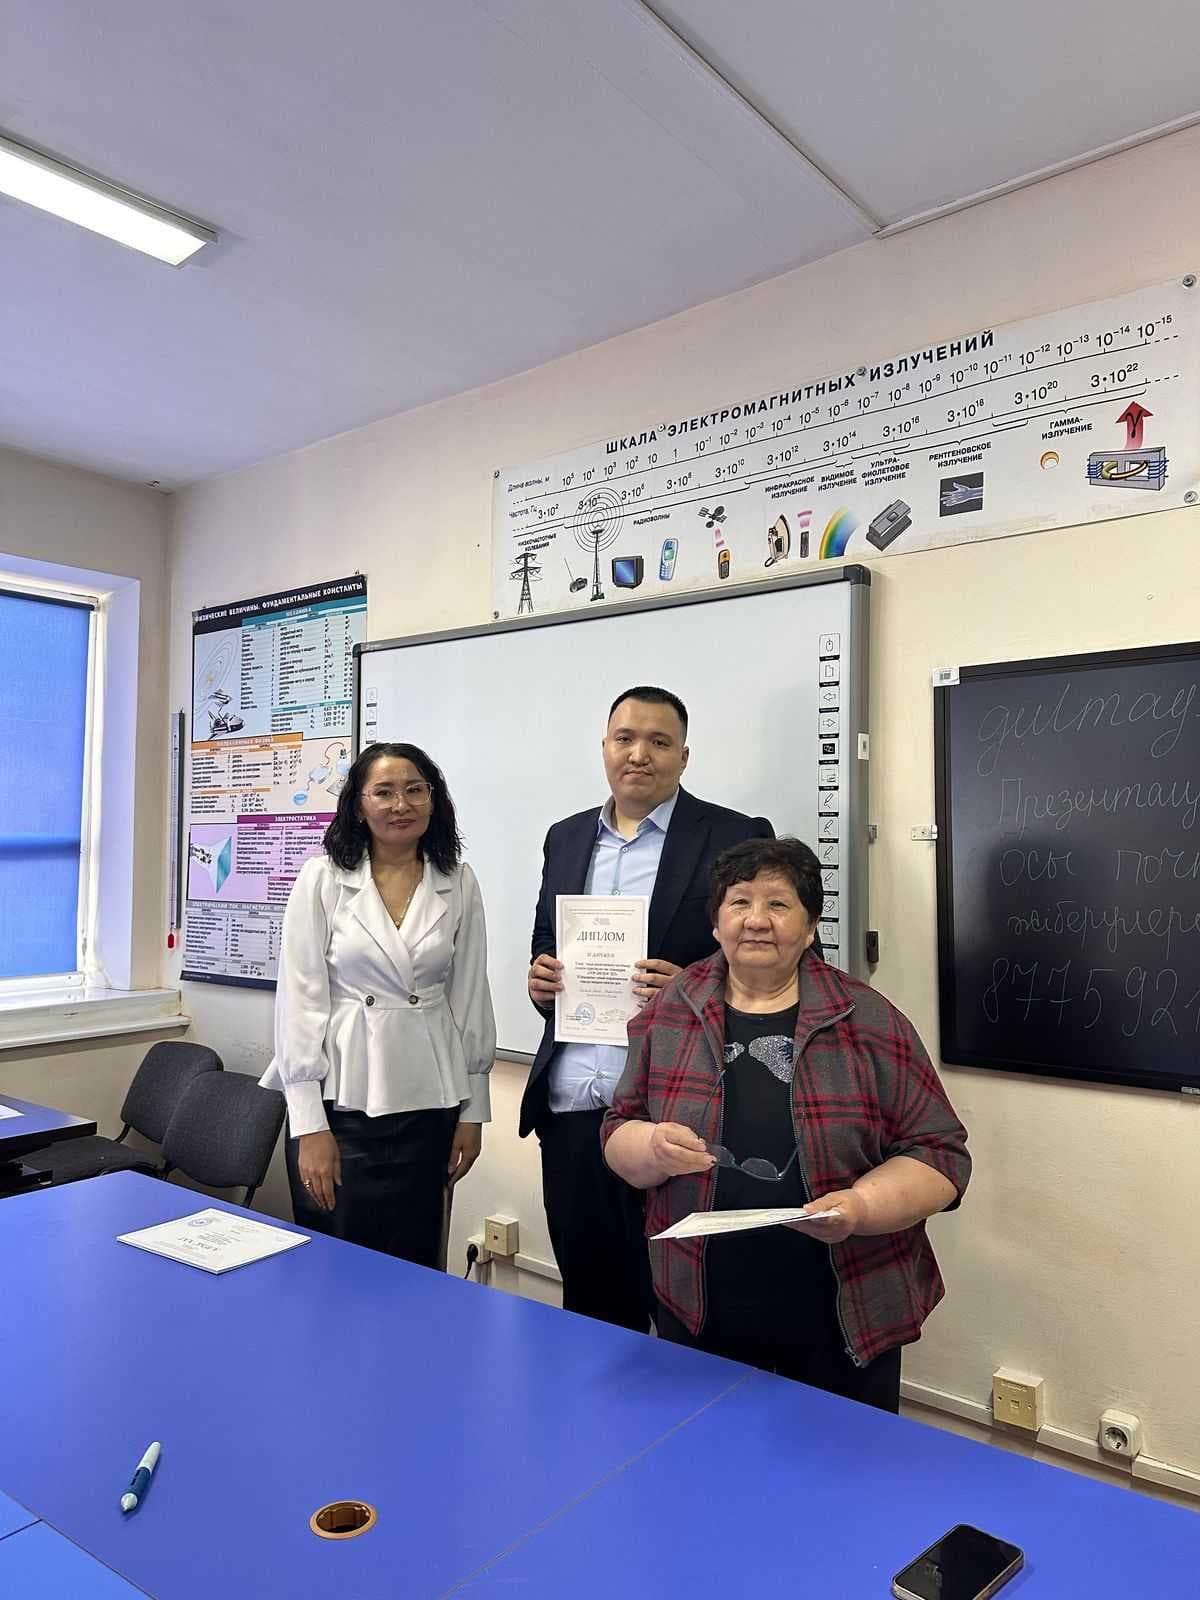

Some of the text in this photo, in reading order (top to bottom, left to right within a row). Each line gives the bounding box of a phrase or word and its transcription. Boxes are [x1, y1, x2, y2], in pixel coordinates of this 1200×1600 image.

[606, 329, 994, 454] ШКАЛА ЭЛЕКТРОМАГНИТНЫХ ИЗЛУЧЕНИЙ
[1050, 416, 1083, 429] ГАММА-
[1041, 423, 1093, 440] ИЗЛУЧЕНИЕ
[929, 441, 992, 461] РЕНТГЕНОВСКОЕ
[648, 453, 657, 465] 10
[870, 457, 900, 469] УЛЬТРА-
[937, 453, 983, 468] ИЗЛУЧЕНИЕ
[821, 470, 854, 482] ВИДИМОЕ
[861, 463, 910, 479] ФИОЛЕТОВОЕ
[765, 476, 815, 493] ИНФРАКРАСНОЕ
[818, 477, 857, 491] ИЗЛУЧЕНИЕ
[865, 472, 906, 486] ИЗЛУЧЕНИЕ
[771, 486, 808, 499] ИЗЛУЧЕНИЕ
[633, 513, 670, 526] РАДИОВОЛНЫ
[262, 591, 321, 608] ФУНДАМЕНТАЛЬНЫЕ
[323, 582, 363, 596] КОНСТАНТЫ
[577, 931, 625, 942] ДИПЛОМ
